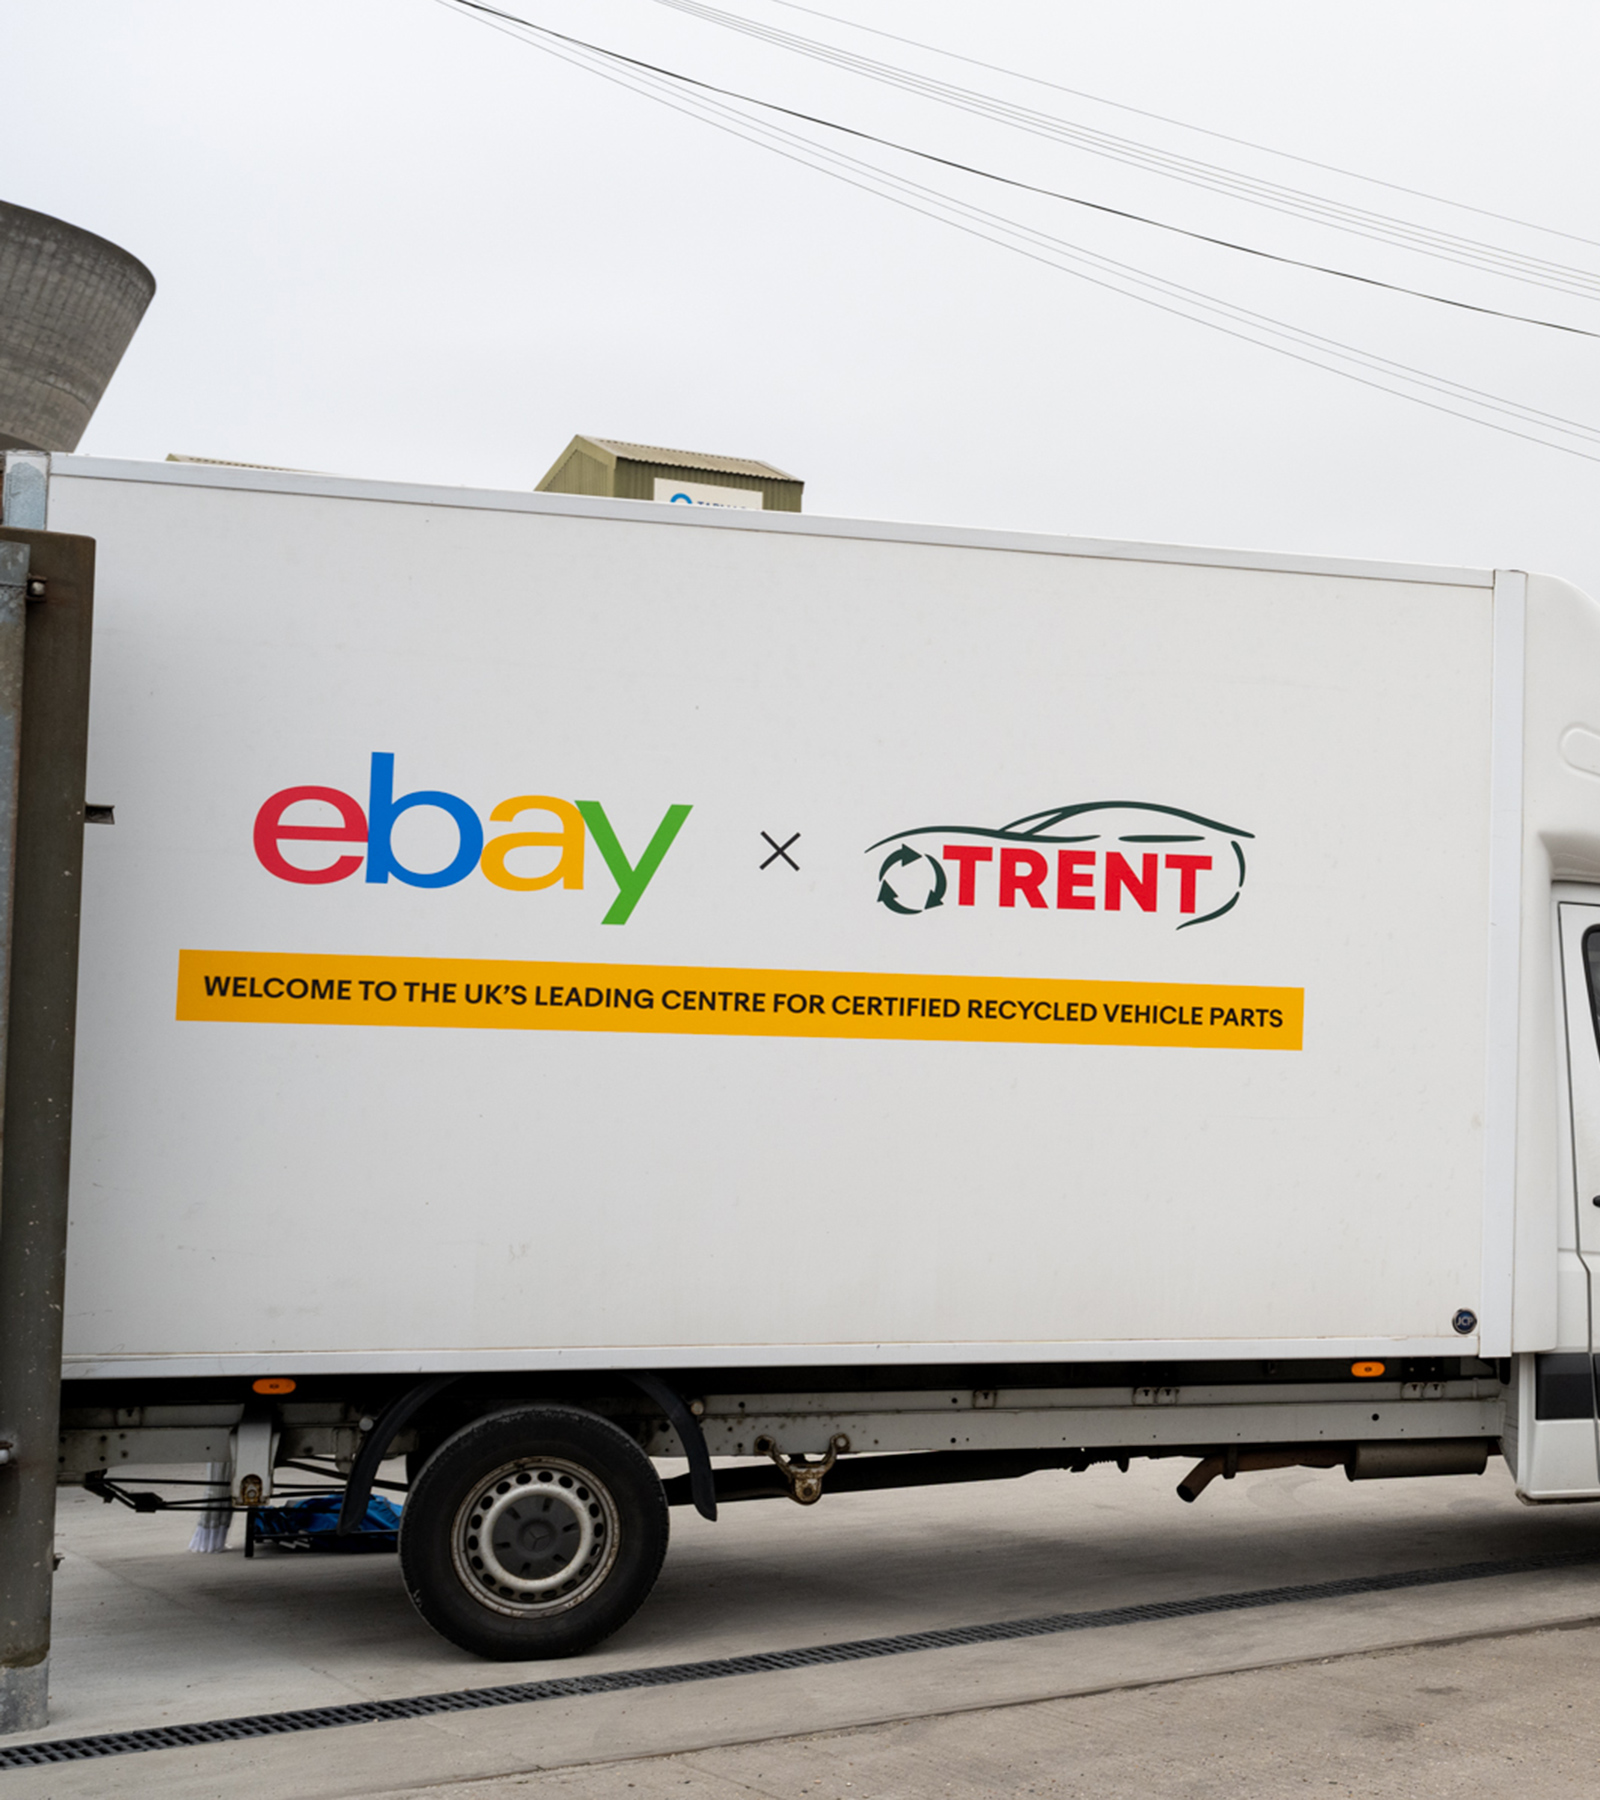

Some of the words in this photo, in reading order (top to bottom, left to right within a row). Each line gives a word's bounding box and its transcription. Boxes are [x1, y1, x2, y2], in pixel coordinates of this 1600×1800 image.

[253, 751, 693, 925] ebay
[942, 844, 1213, 914] TRENT
[203, 975, 353, 1001] WELCOME
[358, 980, 398, 1002] TO
[403, 981, 457, 1004] THE
[534, 985, 654, 1010] LEADING
[661, 989, 766, 1013] CENTRE
[773, 993, 826, 1015] FOR
[831, 994, 961, 1018] CERTIFIED
[967, 999, 1098, 1022] RECYCLED
[1102, 1003, 1204, 1026] VEHICLE
[1209, 1007, 1283, 1028] PARTS
